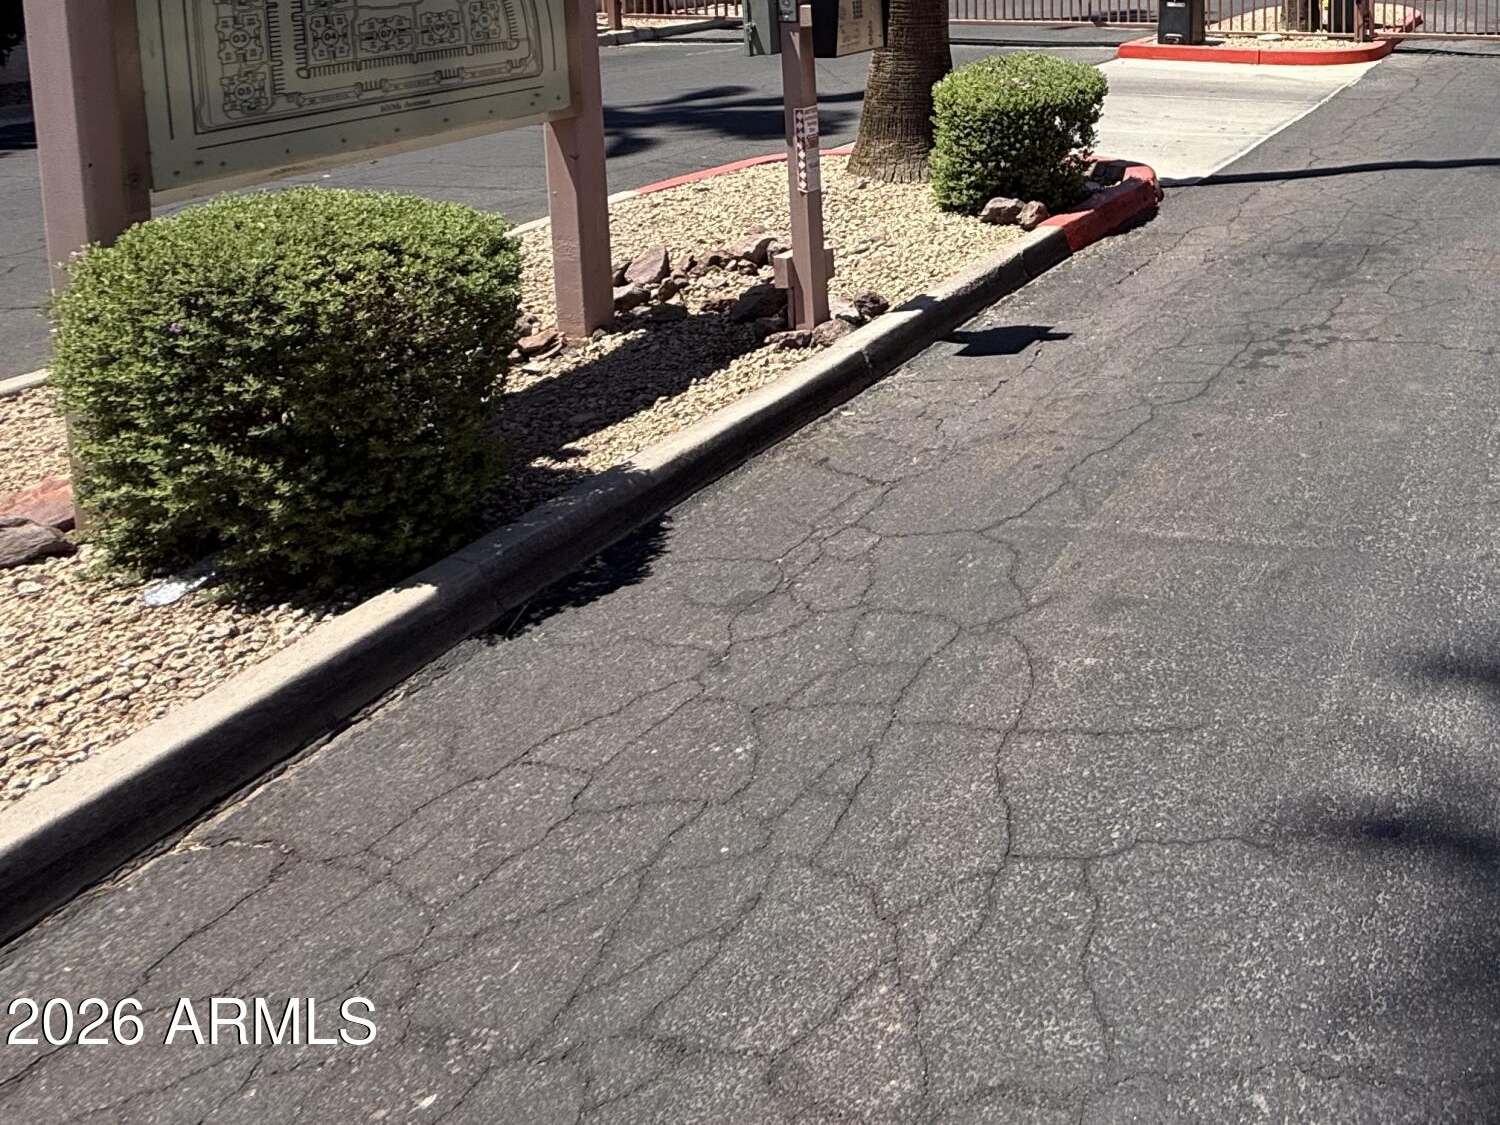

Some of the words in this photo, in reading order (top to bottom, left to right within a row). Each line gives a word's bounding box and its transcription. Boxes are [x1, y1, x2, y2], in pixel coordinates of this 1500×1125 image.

[324, 32, 337, 41] 04
[380, 28, 392, 37] 07
[232, 34, 247, 43] 03
